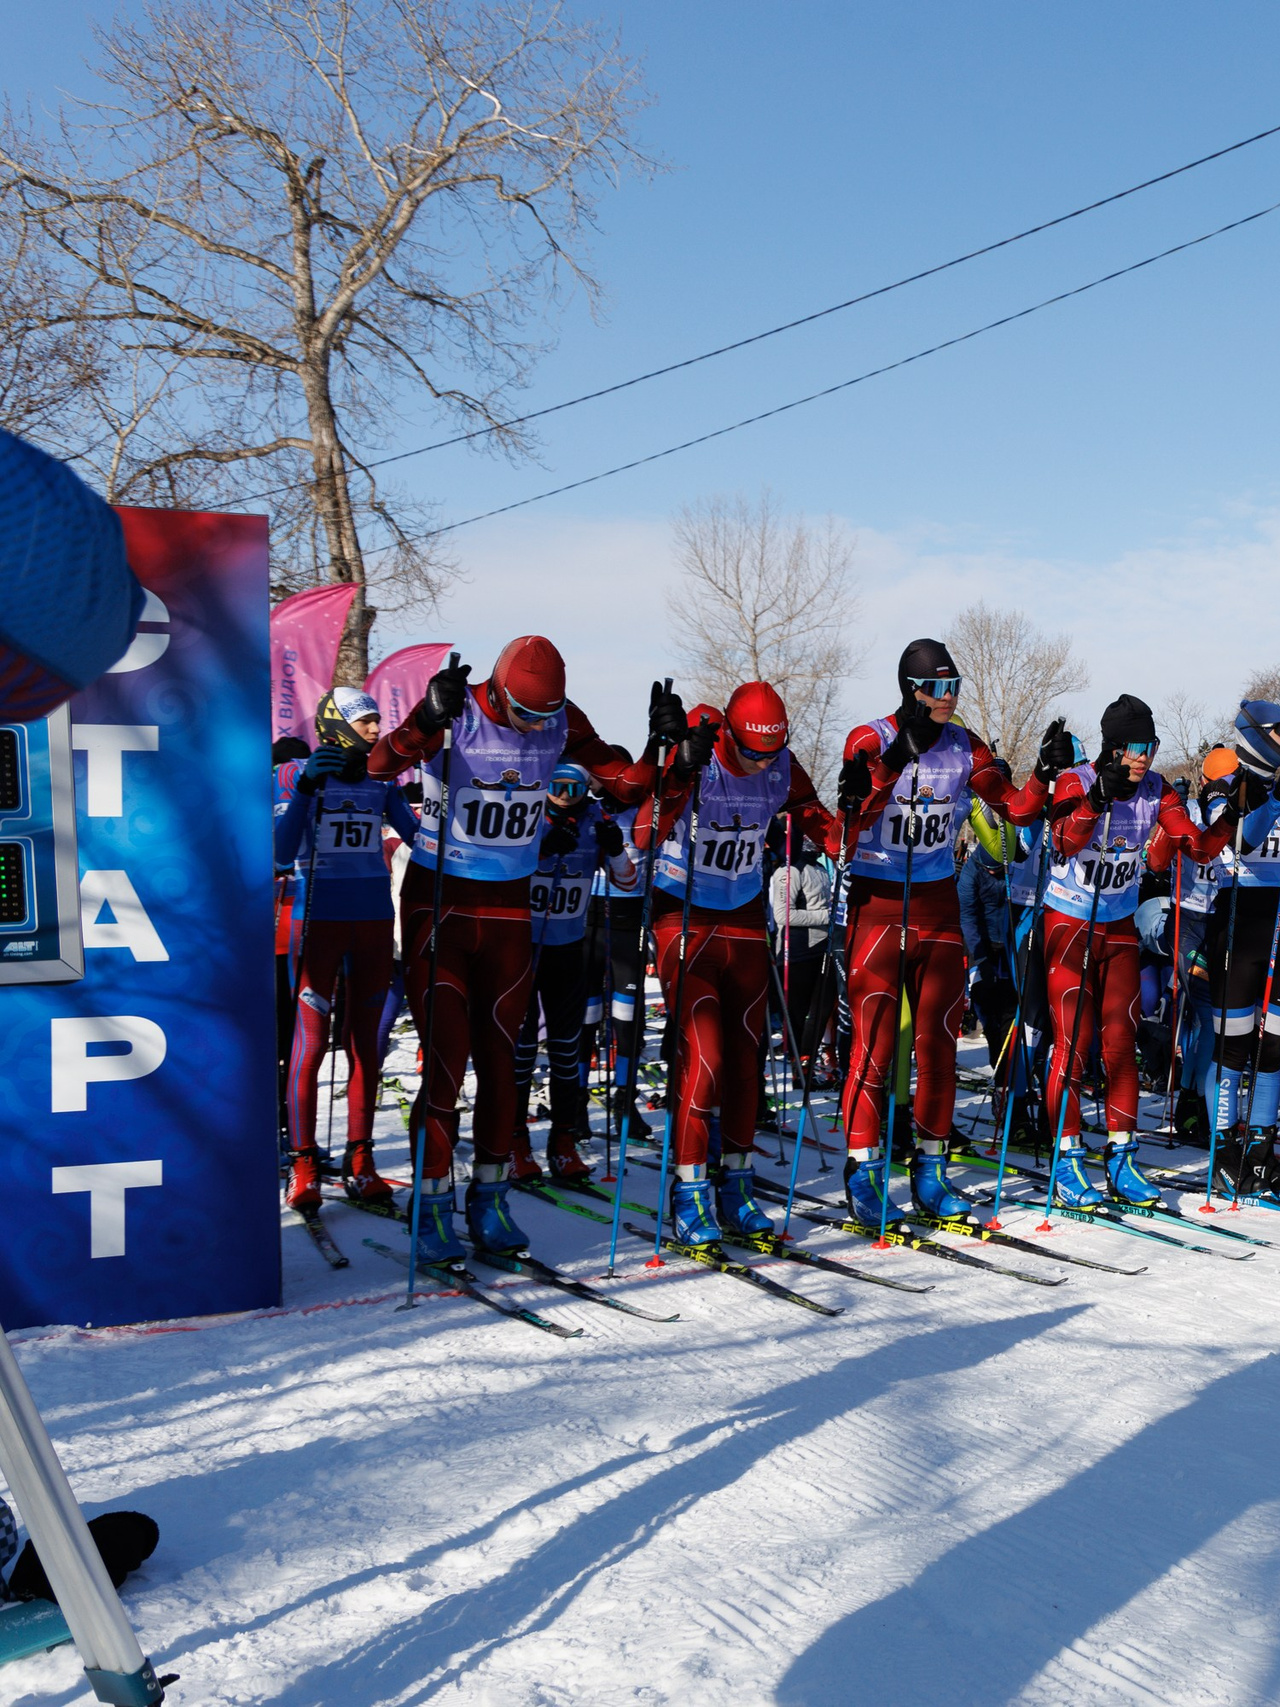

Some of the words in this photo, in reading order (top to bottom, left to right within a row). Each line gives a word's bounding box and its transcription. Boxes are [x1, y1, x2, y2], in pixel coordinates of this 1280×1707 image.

[279, 650, 298, 719] ВИДОВ
[389, 687, 403, 730] ИДОВ
[745, 721, 786, 734] LUKOIL
[330, 821, 373, 848] 757
[462, 800, 543, 840] 1082
[1000, 820, 1008, 866] NORDWAY
[530, 884, 582, 915] 909
[842, 1223, 905, 1247] FISCHER
[904, 1215, 974, 1237] FISCHER
